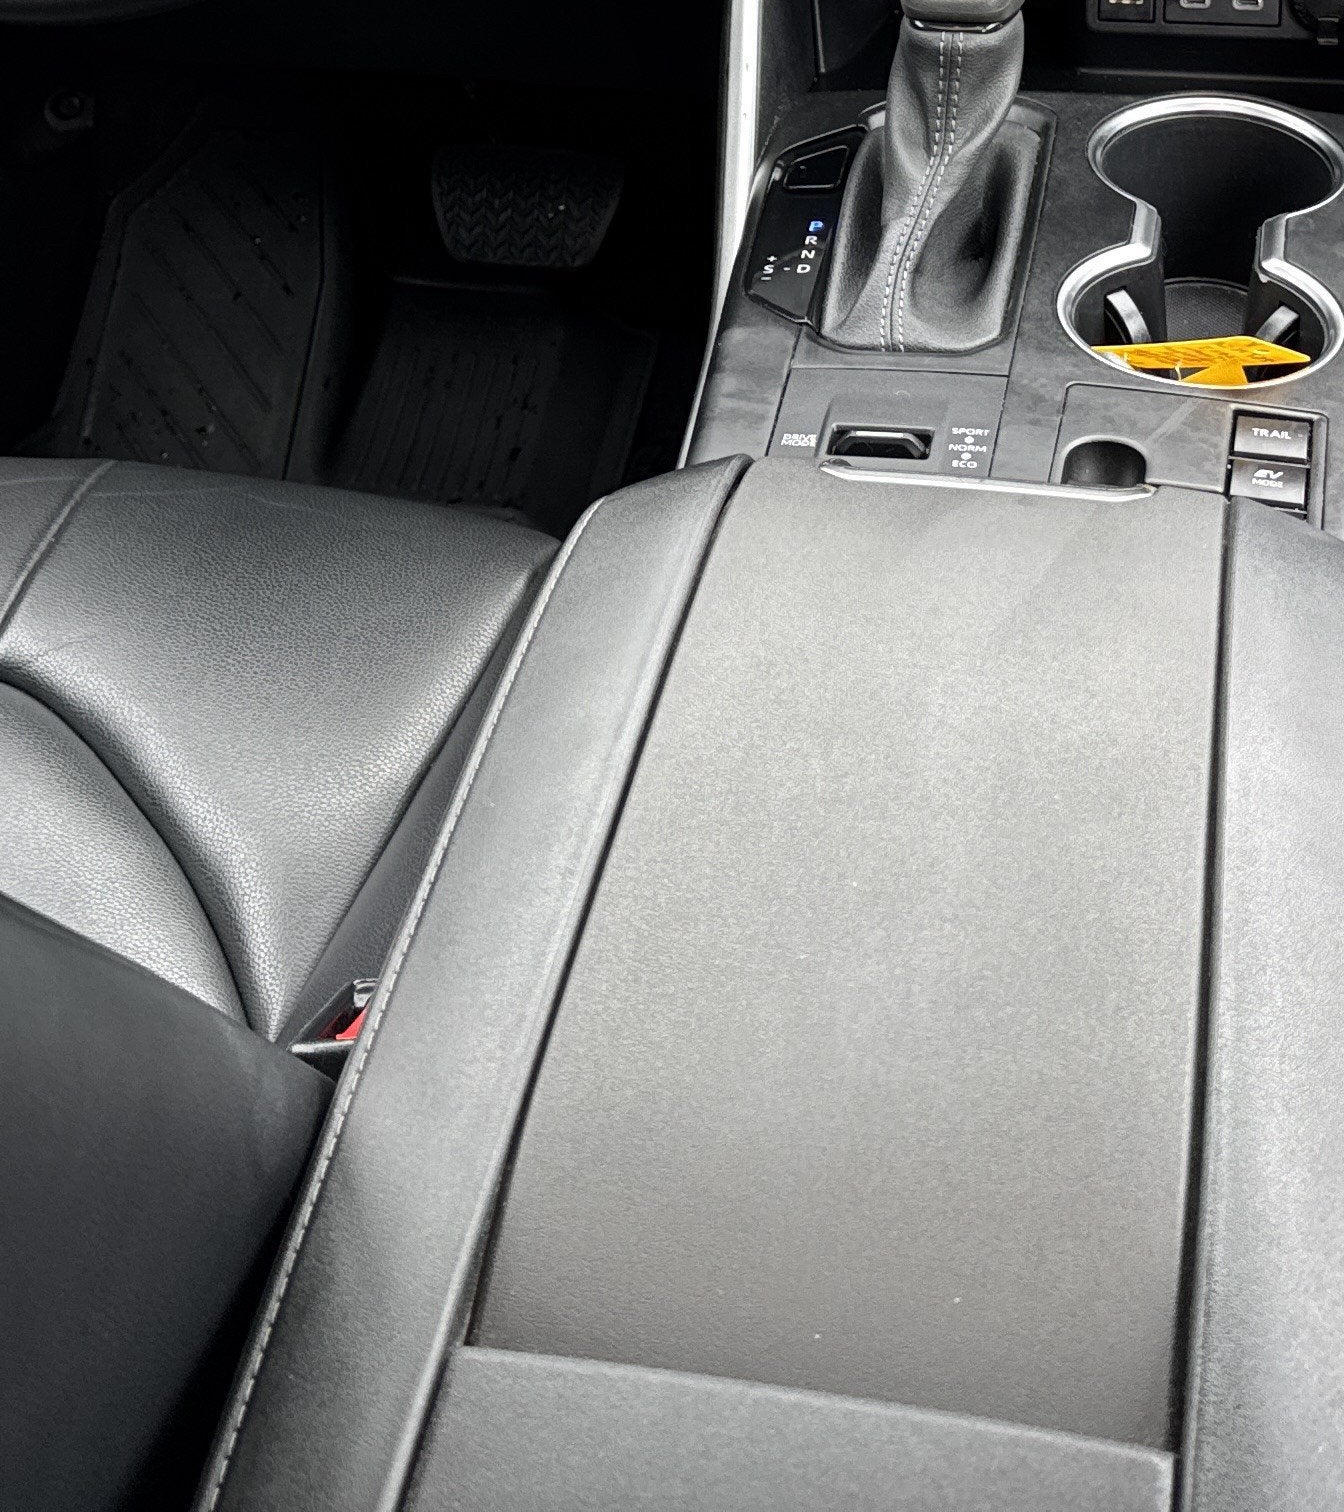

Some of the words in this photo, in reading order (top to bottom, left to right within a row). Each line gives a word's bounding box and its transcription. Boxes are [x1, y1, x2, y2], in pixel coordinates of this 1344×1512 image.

[808, 220, 824, 232] P
[804, 235, 818, 245] R
[800, 249, 815, 259] N
[762, 264, 774, 274] S
[796, 264, 811, 274] D
[952, 427, 990, 437] SPORT
[1252, 427, 1292, 440] TRAIL
[780, 439, 816, 447] MODE
[948, 443, 987, 453] NORM
[952, 460, 978, 469] ECO
[1252, 478, 1284, 488] MODE
